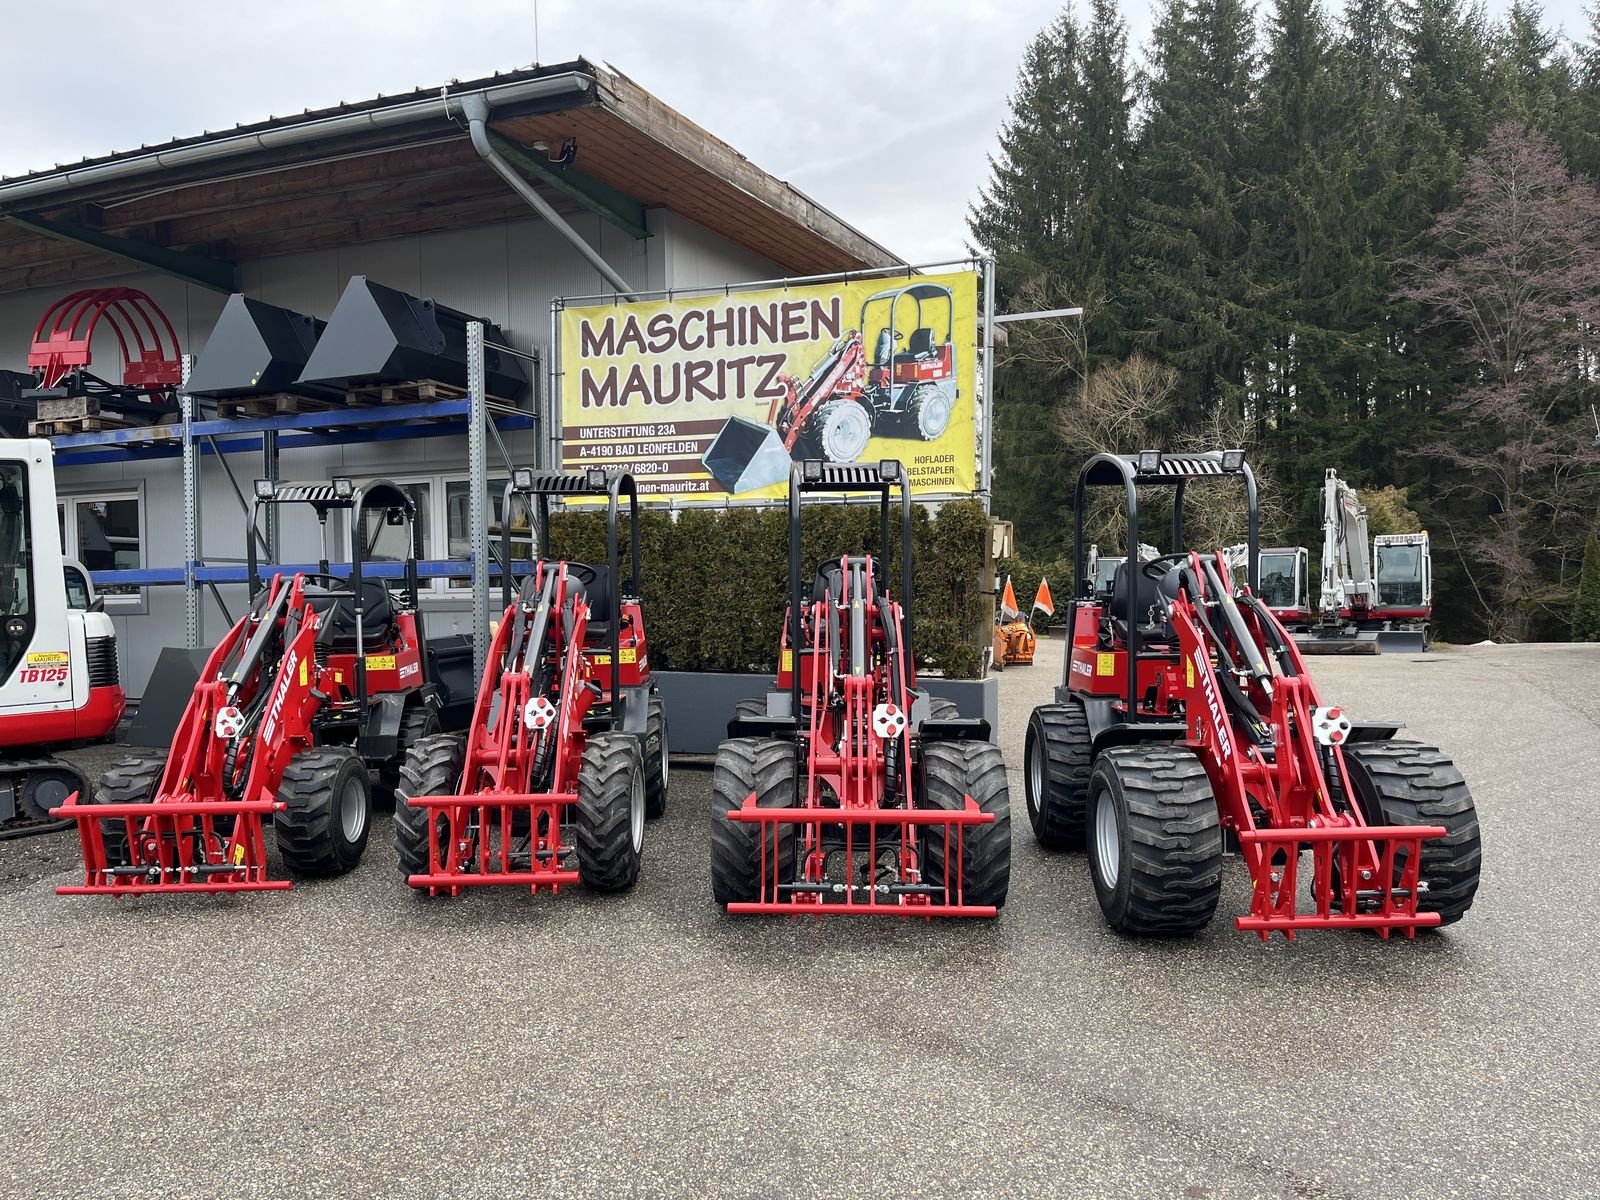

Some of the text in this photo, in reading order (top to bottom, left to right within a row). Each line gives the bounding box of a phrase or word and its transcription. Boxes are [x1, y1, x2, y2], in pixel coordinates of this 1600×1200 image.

[580, 296, 841, 358] MASCHINEN
[580, 353, 788, 409] MAURITZ
[579, 424, 676, 439] UNTERSTIFTUNG 23A
[579, 441, 698, 457] A-4190 BAD LEONFELDEN
[914, 454, 955, 464] HOFLADER
[907, 466, 955, 476] BELSTAPLER
[636, 480, 710, 493] inen-mauritz.at
[909, 477, 955, 487] MASCHINEN
[20, 668, 68, 683] TB125
